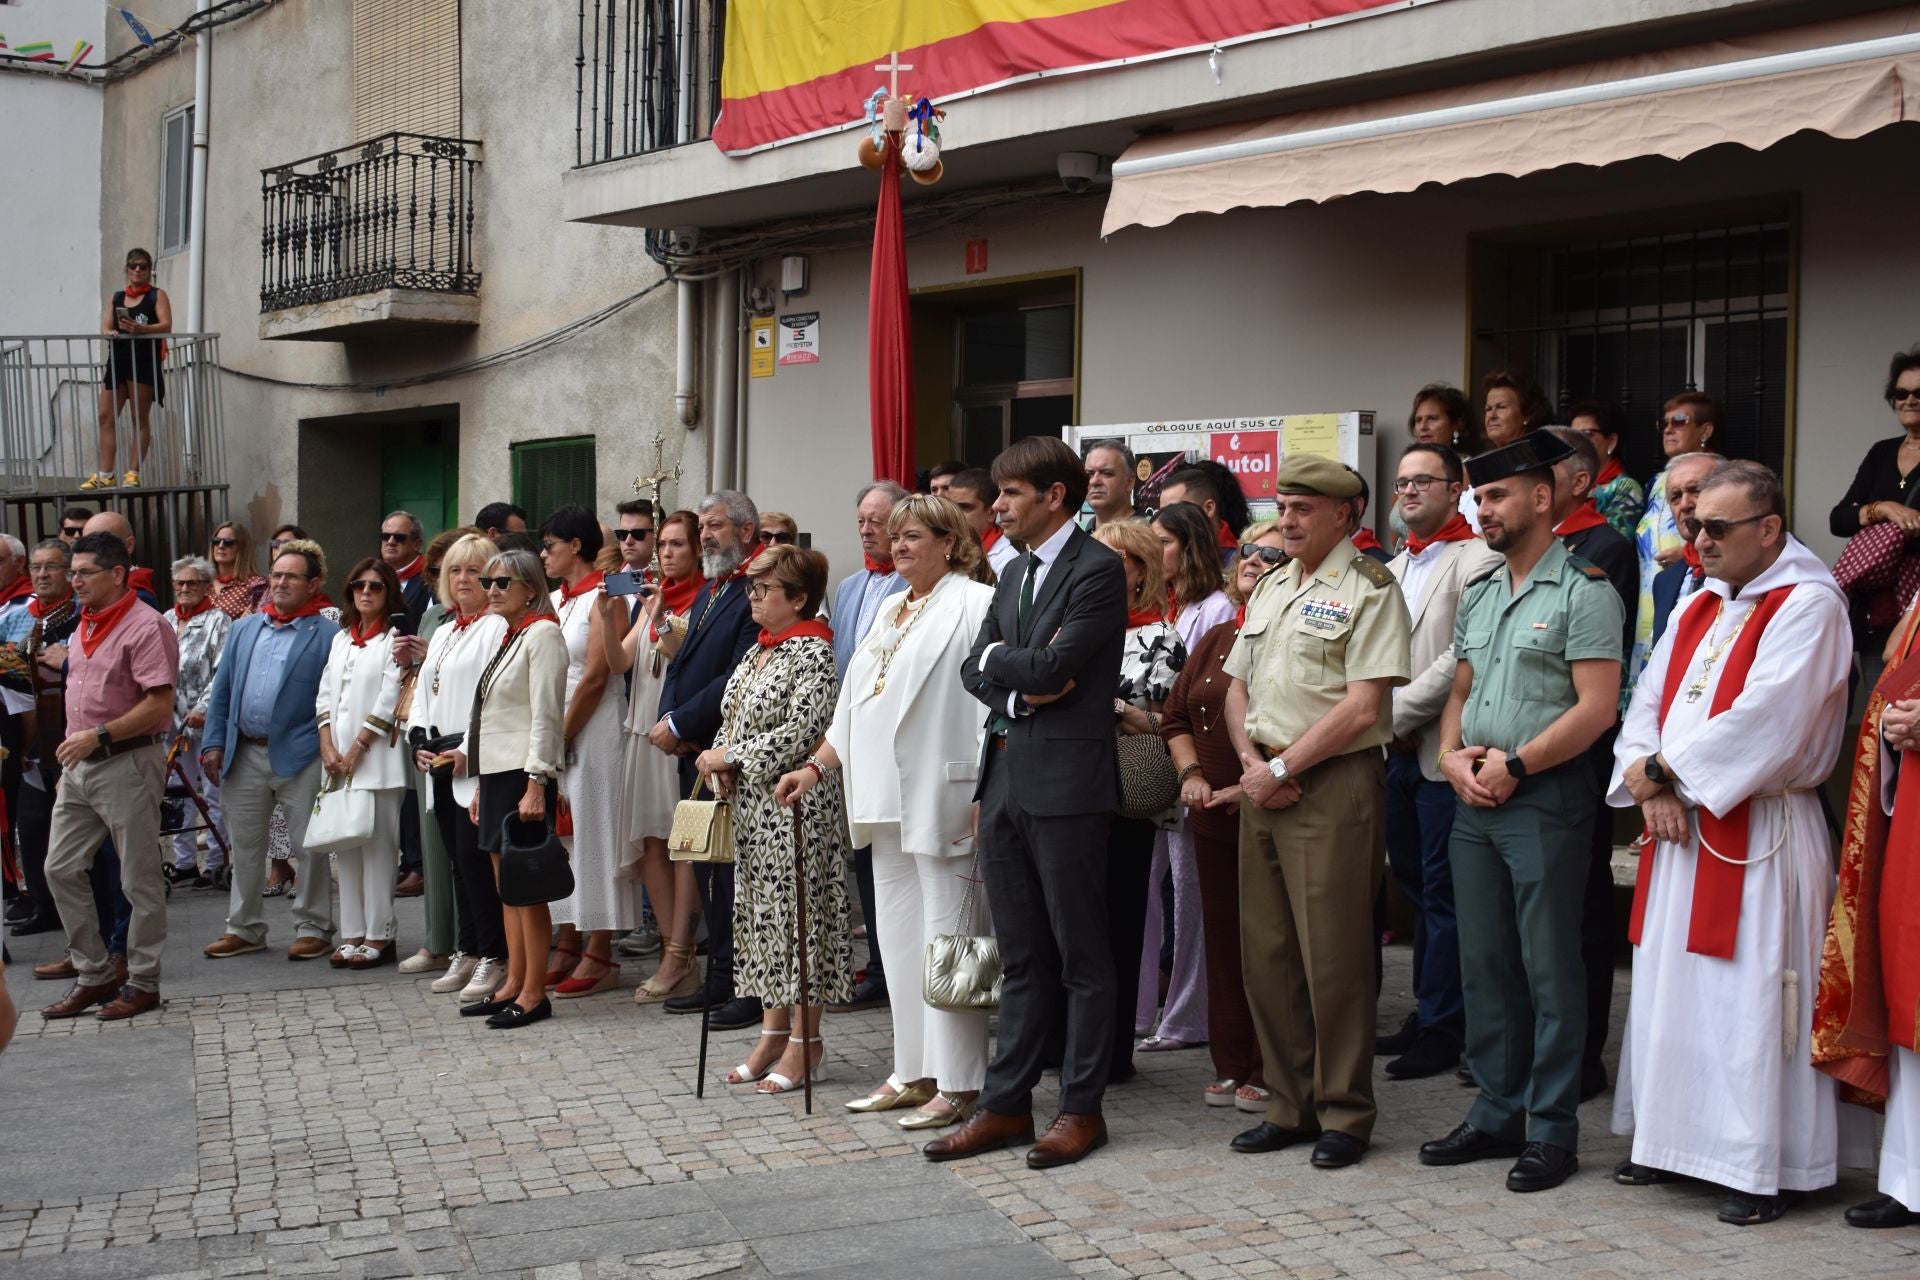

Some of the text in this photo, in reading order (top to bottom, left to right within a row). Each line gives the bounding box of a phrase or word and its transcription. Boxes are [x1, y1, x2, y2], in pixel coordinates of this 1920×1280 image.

[1147, 423, 1202, 432] COLOQUE
[1206, 420, 1236, 430] AQUÍ
[1240, 420, 1265, 428] SUS
